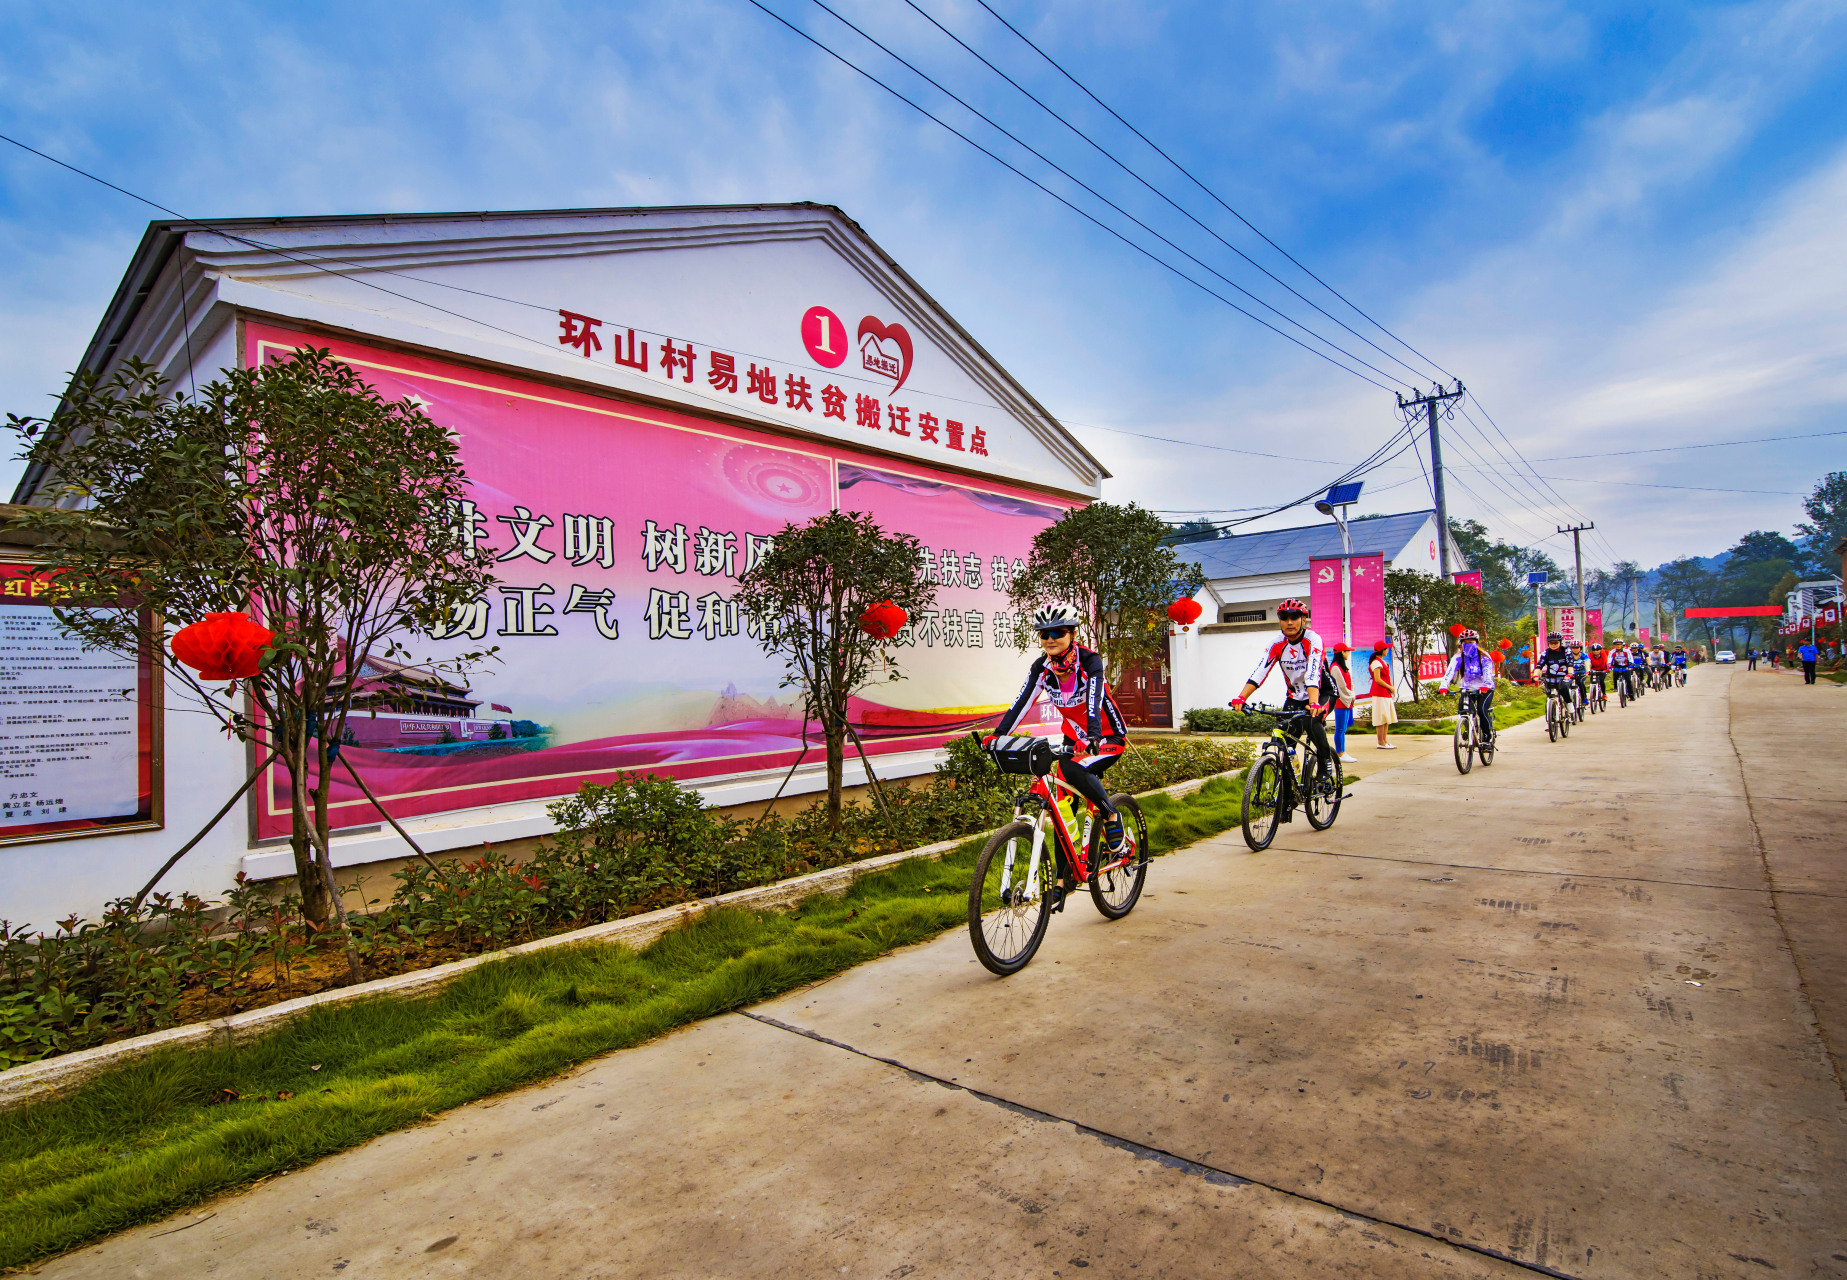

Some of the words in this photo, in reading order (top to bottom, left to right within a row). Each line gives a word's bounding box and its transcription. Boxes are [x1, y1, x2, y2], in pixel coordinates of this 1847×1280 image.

[815, 315, 836, 355] 1
[558, 308, 989, 457] 环山村易地扶贫搬迁安置点
[865, 354, 897, 375] 易地搬迁
